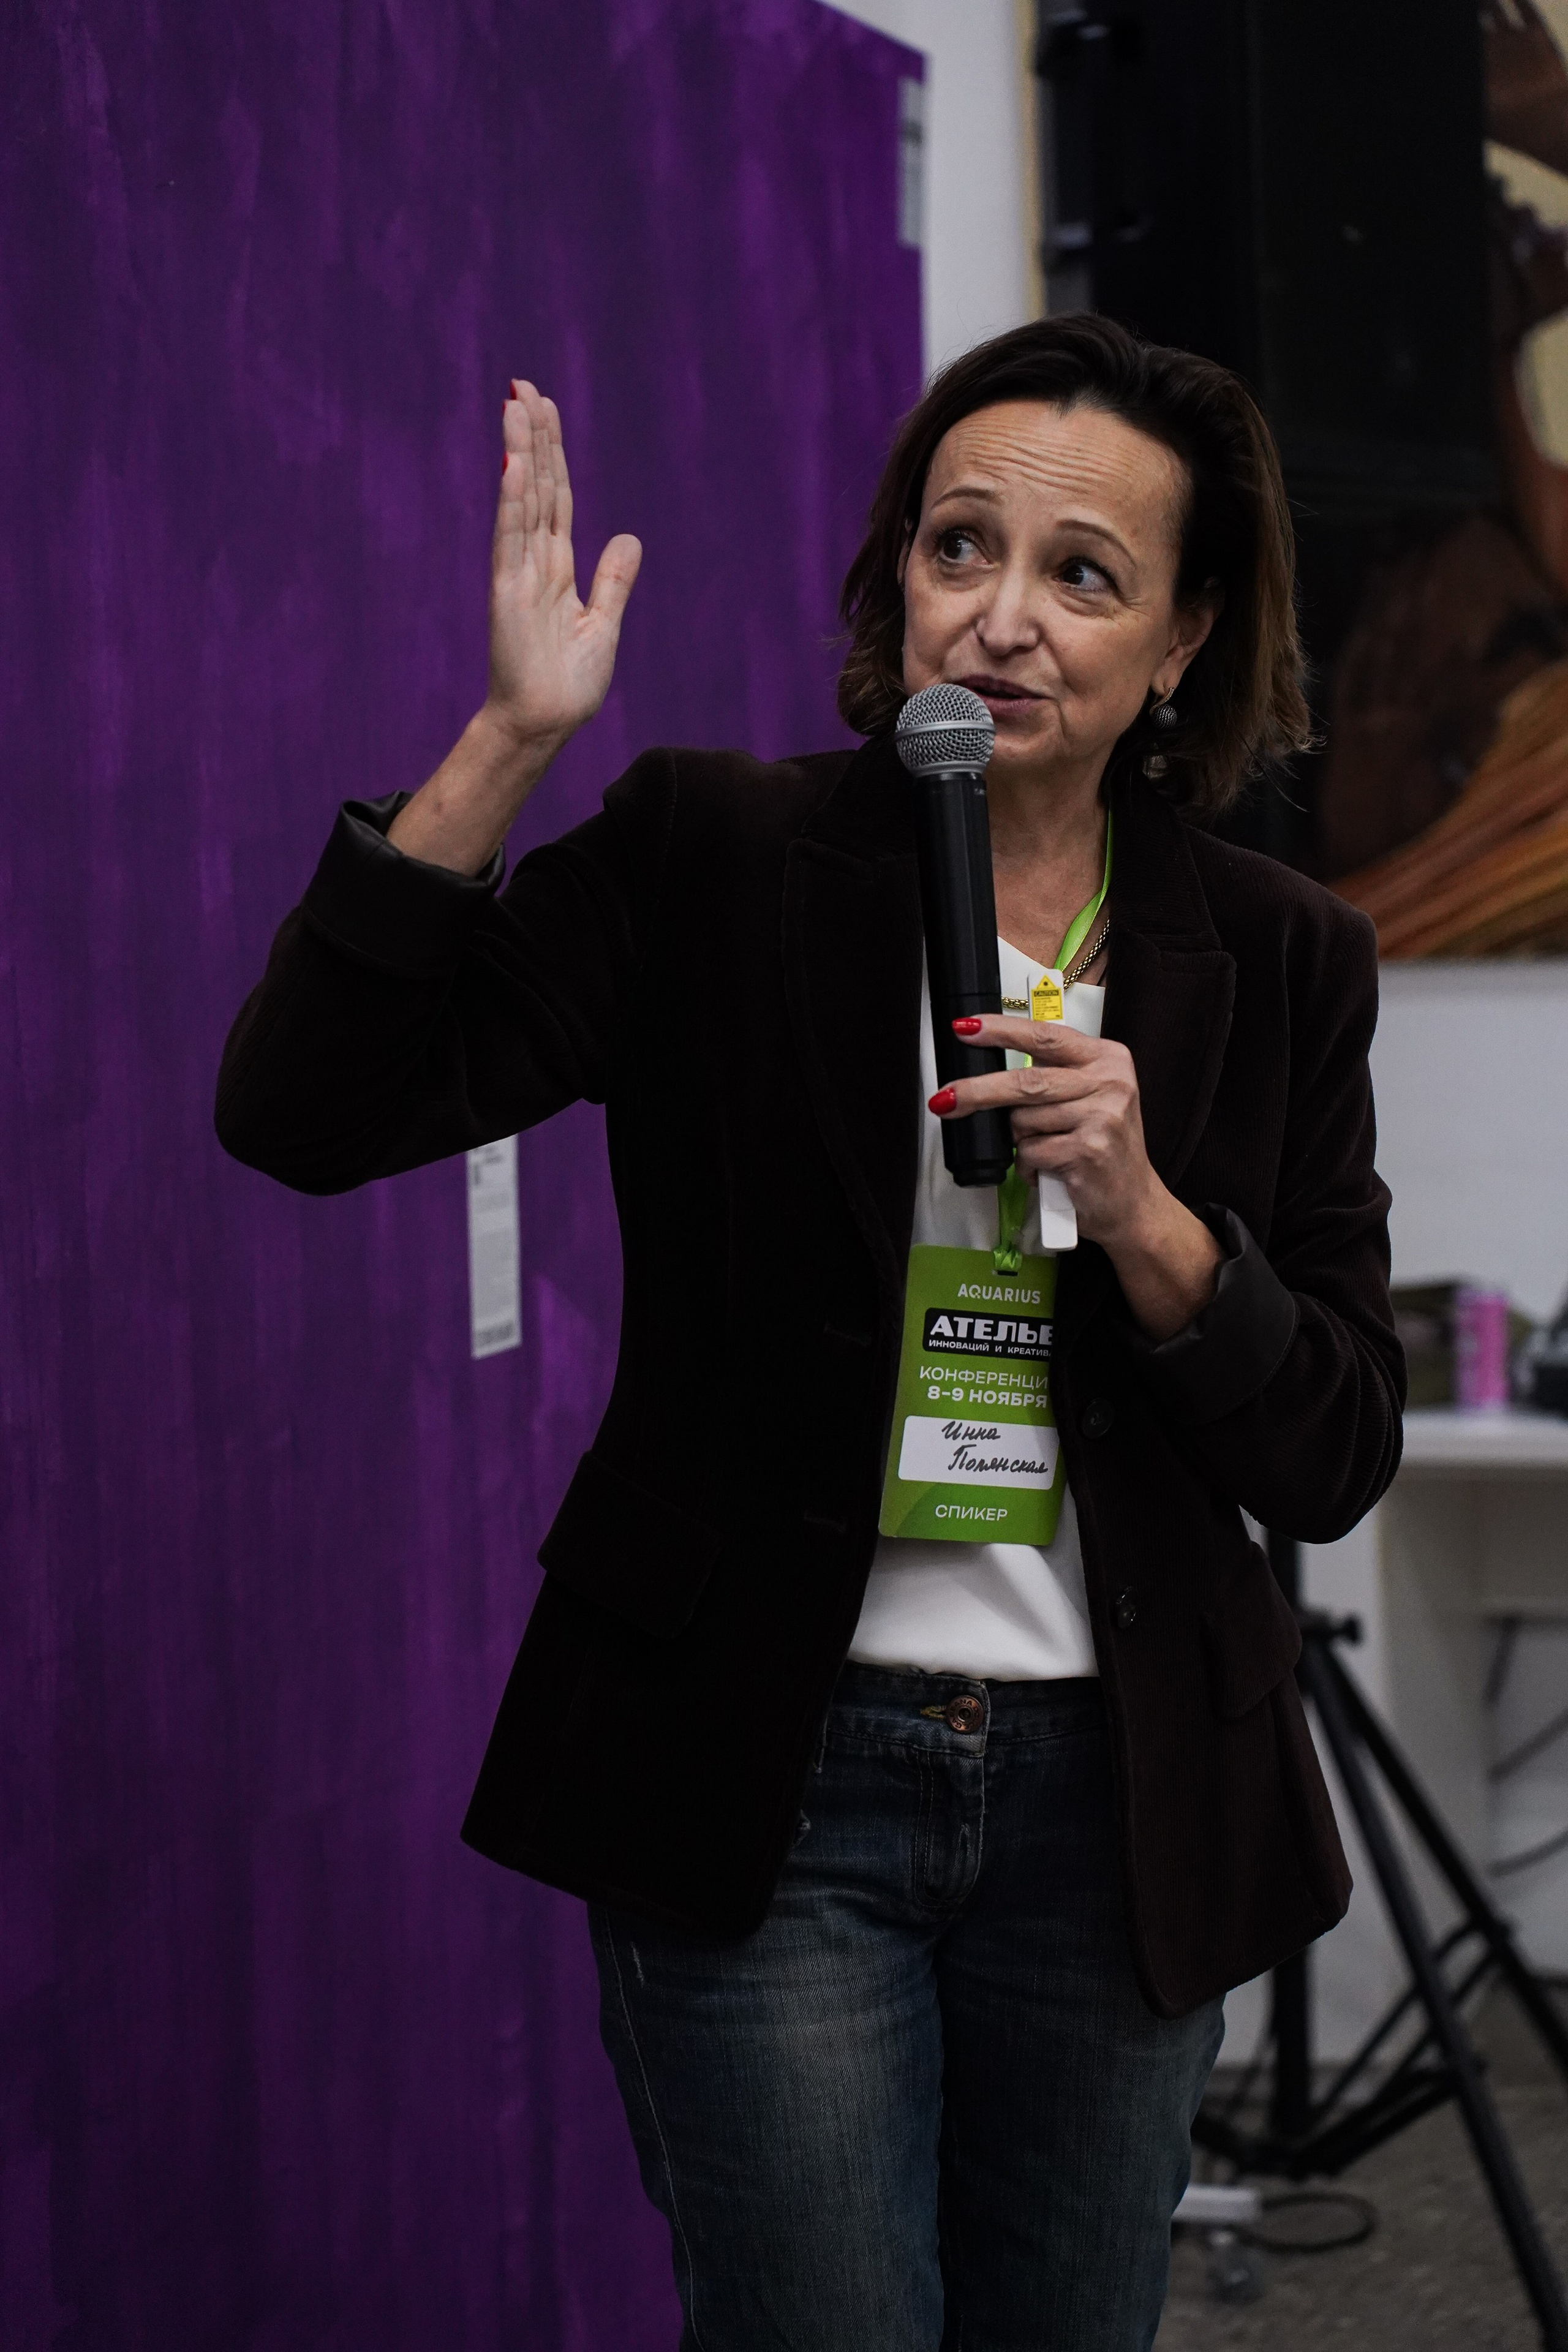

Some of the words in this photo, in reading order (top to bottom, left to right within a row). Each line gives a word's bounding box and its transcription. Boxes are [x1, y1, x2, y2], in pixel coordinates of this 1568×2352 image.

[957, 1284, 1041, 1304] AQUARIUS
[930, 1315, 1054, 1345] АТЕЛЬЕ
[929, 1340, 989, 1352] ИННОВАЦИЙ
[969, 1389, 1047, 1408] НОЯБРЯ
[941, 1420, 1001, 1441] Инна
[935, 1504, 1008, 1521] СПИКЕР
